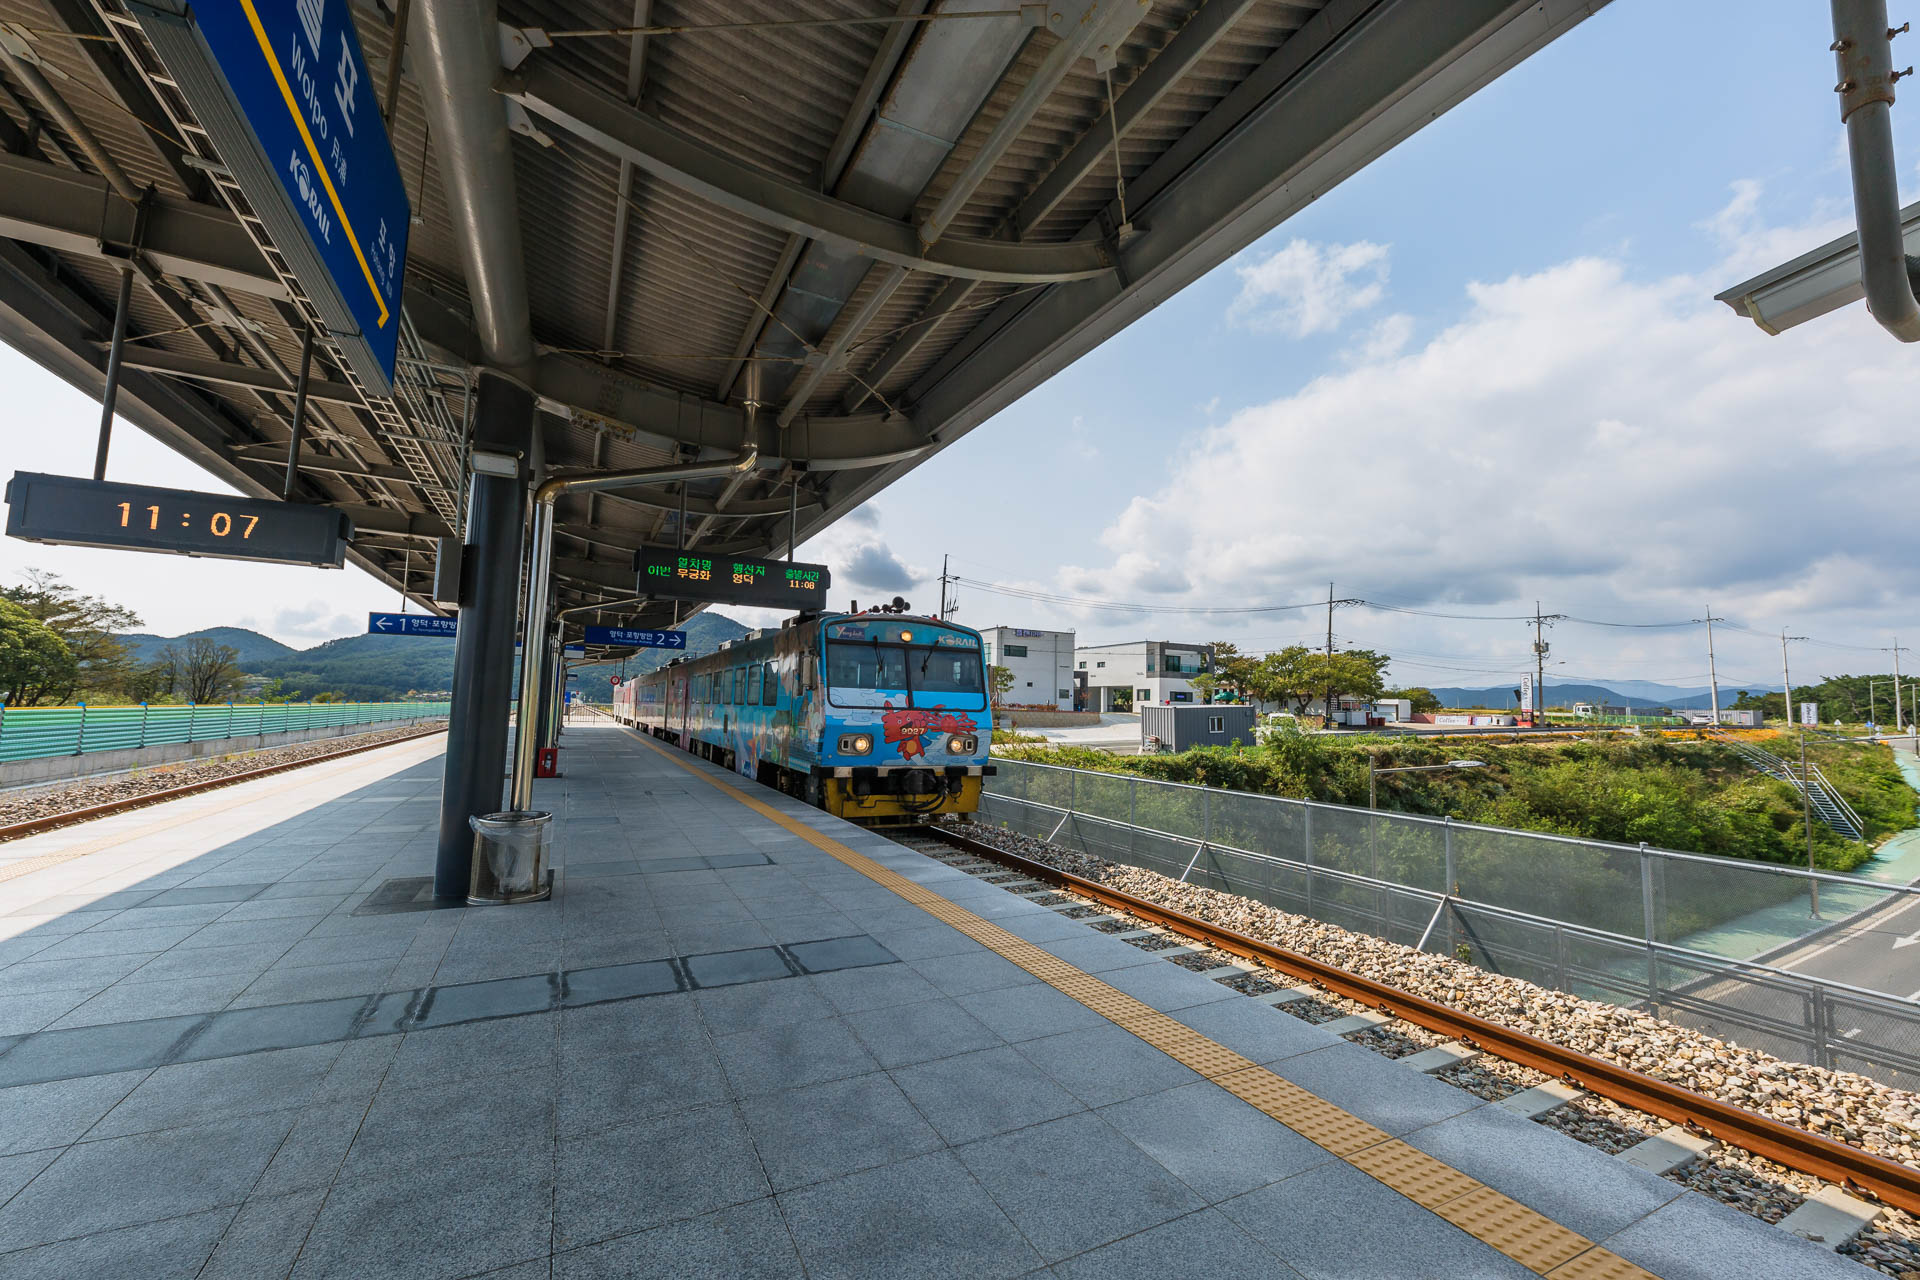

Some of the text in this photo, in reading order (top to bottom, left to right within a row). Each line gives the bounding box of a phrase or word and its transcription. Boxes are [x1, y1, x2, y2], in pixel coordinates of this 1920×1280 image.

[292, 32, 328, 140] Wolpo
[290, 149, 331, 245] KORAIL
[378, 217, 396, 279] 포항
[117, 502, 259, 539] 11:07
[648, 565, 671, 576] 이번
[677, 568, 815, 590] 무궁화 영덕 11:08
[678, 557, 819, 581] 열차명 행선지 출발시간
[399, 618, 406, 631] 1
[656, 633, 665, 645] 2
[937, 634, 977, 647] KORAIL
[901, 727, 925, 735] 9027
